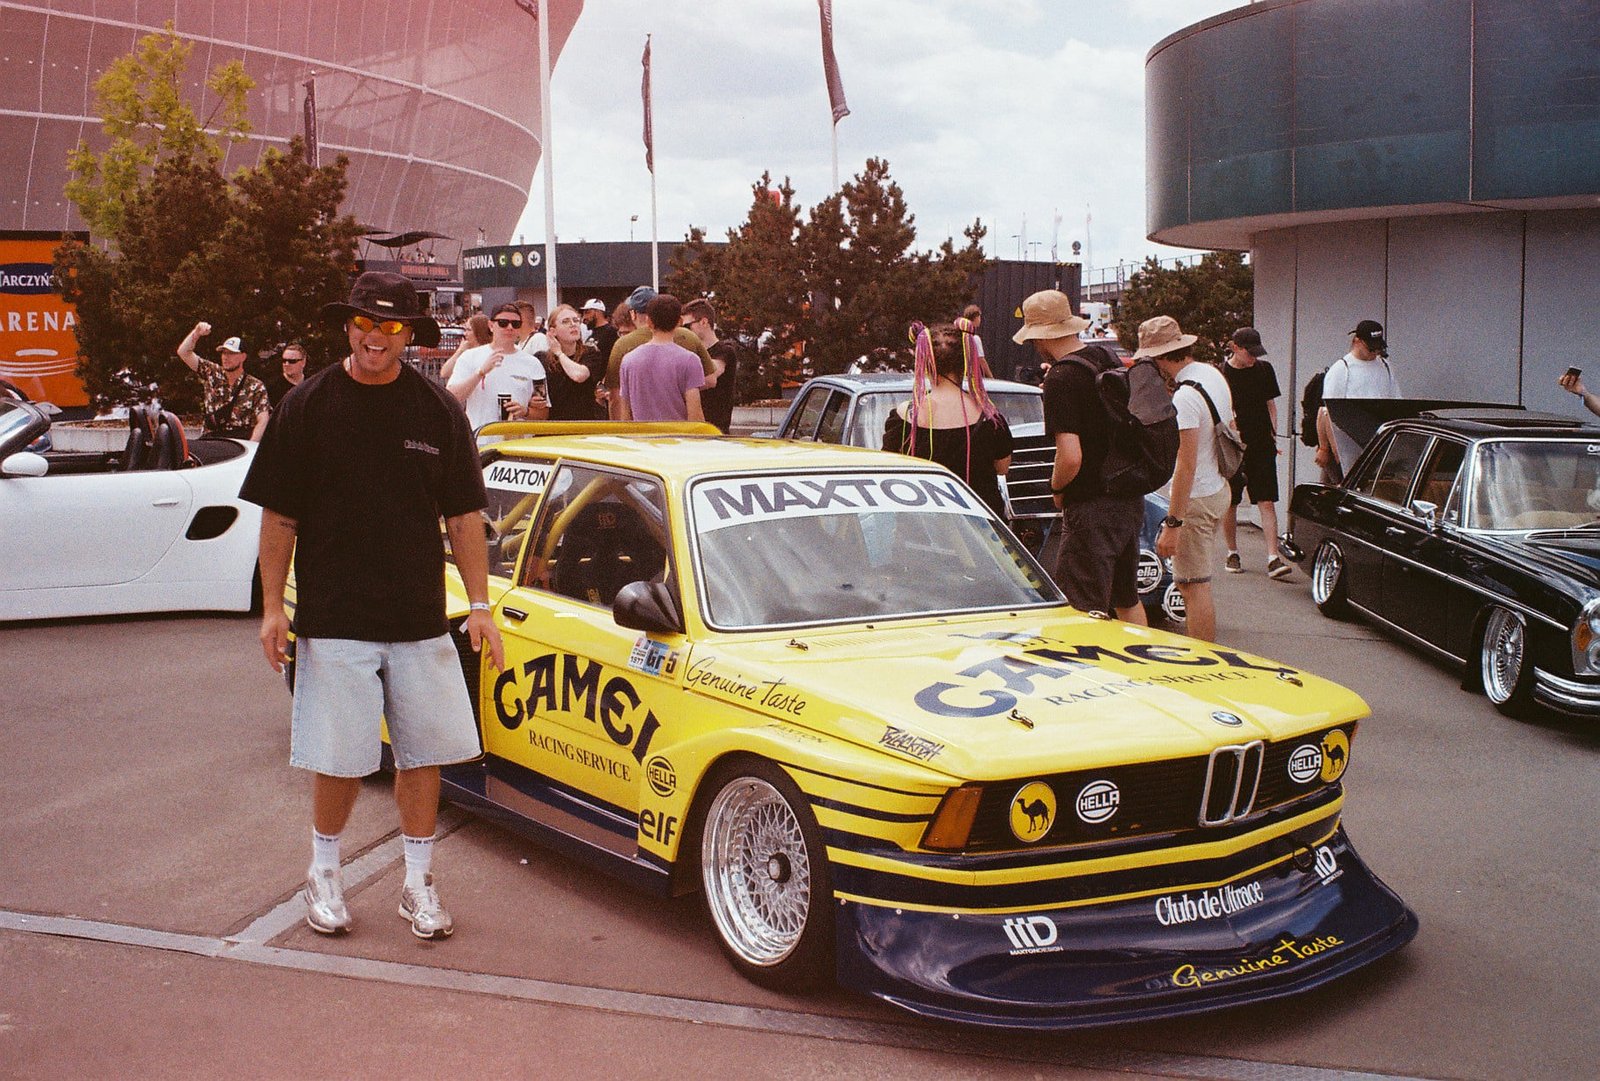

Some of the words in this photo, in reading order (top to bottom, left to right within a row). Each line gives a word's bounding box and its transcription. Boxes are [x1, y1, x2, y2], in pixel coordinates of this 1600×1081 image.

[500, 255, 506, 265] C
[489, 466, 550, 487] MAXTON
[703, 479, 971, 521] MAXTON
[1137, 566, 1158, 577] ella
[665, 651, 680, 675] 5
[913, 644, 1298, 718] CAMEL
[686, 656, 757, 700] Genuine
[760, 676, 806, 716] Taste
[1044, 677, 1154, 706] RACING
[1149, 671, 1257, 685] SERVICE
[493, 653, 661, 767] CAMEL
[529, 729, 575, 761] RACING
[576, 747, 631, 783] SERVICE
[1291, 754, 1322, 772] HELLA
[649, 767, 677, 789] HELLA
[1080, 790, 1120, 811] HELLA
[639, 808, 678, 847] elf
[1155, 894, 1198, 926] Club
[1198, 890, 1222, 920] de
[1219, 881, 1264, 915] Ultrace
[1172, 954, 1289, 988] Genuine
[1273, 935, 1344, 959] Taste
